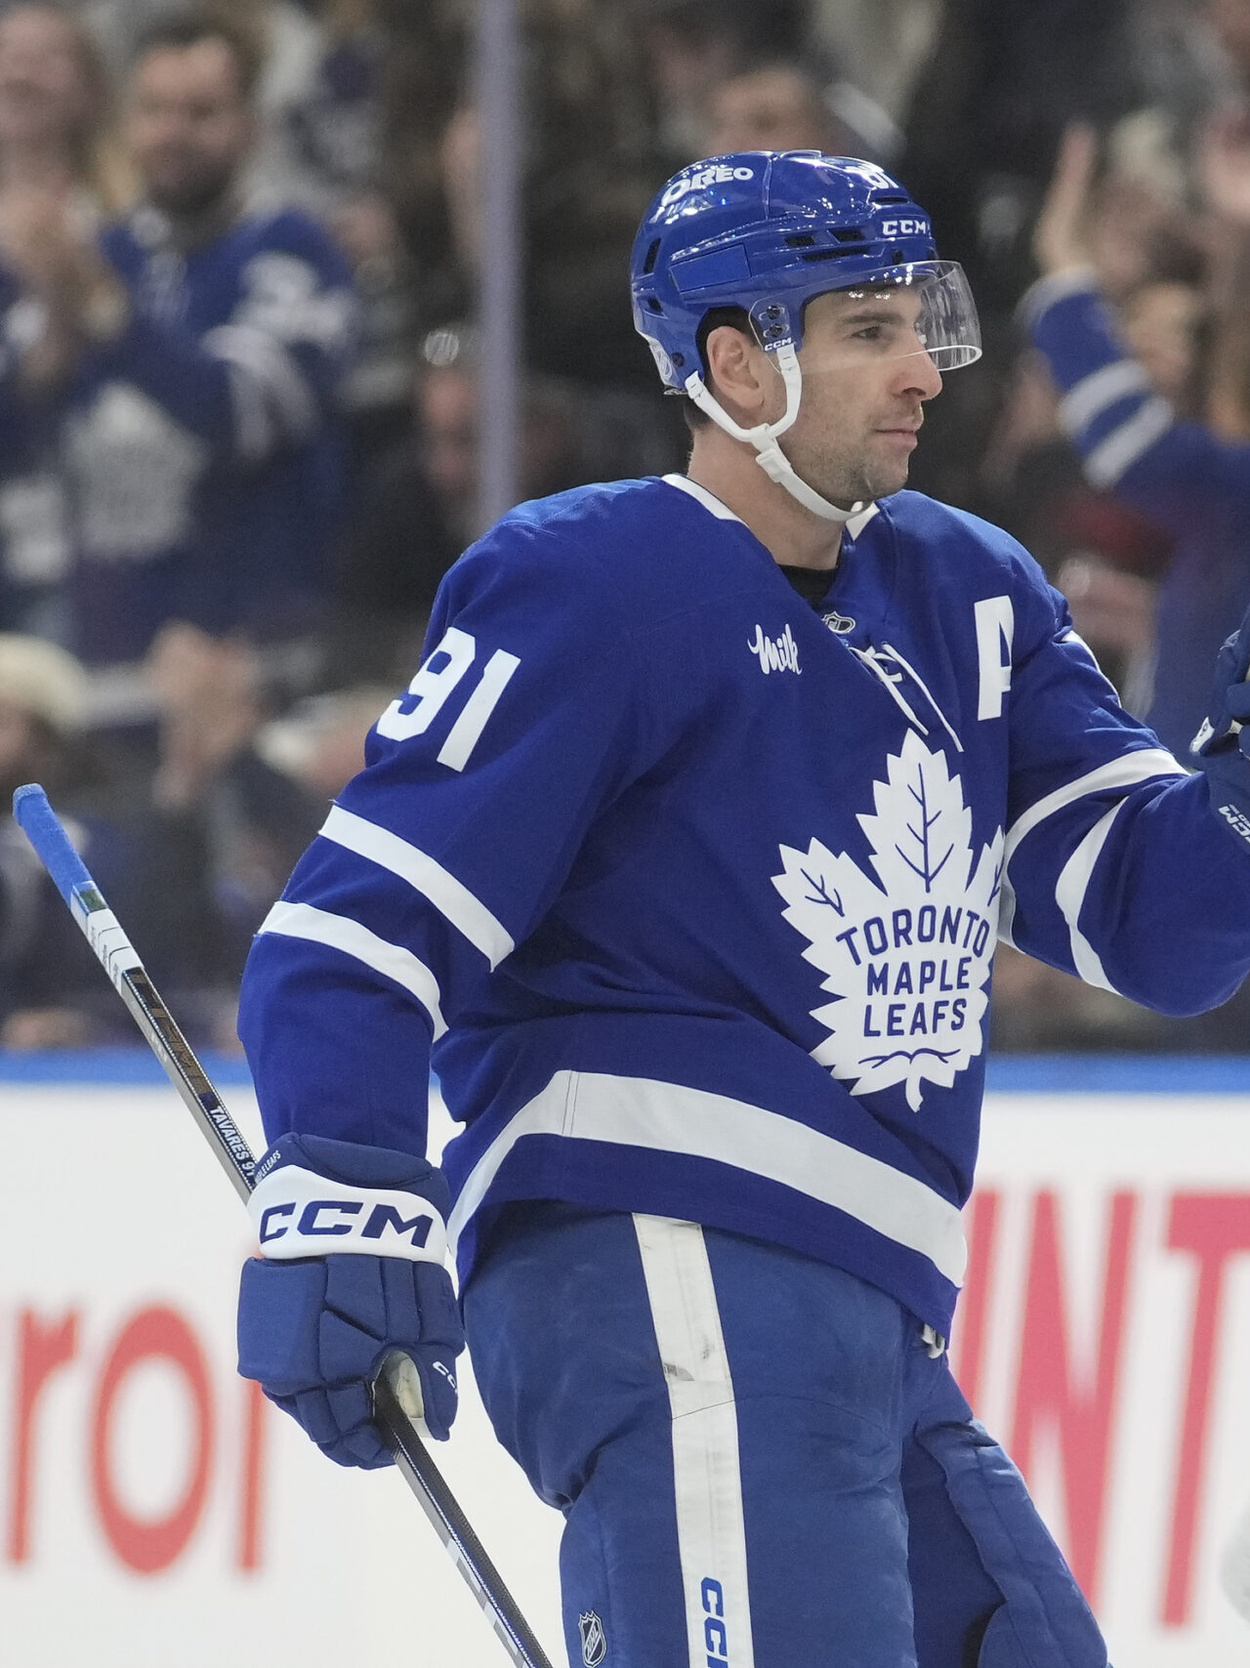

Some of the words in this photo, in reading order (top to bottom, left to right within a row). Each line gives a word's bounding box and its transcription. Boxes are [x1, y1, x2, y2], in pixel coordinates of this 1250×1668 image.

[661, 166, 754, 207] OREO
[882, 219, 927, 236] CCM
[763, 336, 793, 352] CCM
[376, 626, 521, 773] 91
[836, 904, 990, 966] TORONTO
[866, 956, 972, 996] MAPLE
[863, 998, 968, 1037] LEAFS
[209, 1107, 249, 1160] TAVARES
[260, 1200, 434, 1249] CCM
[432, 1361, 457, 1394] CC
[700, 1576, 729, 1668] CC
